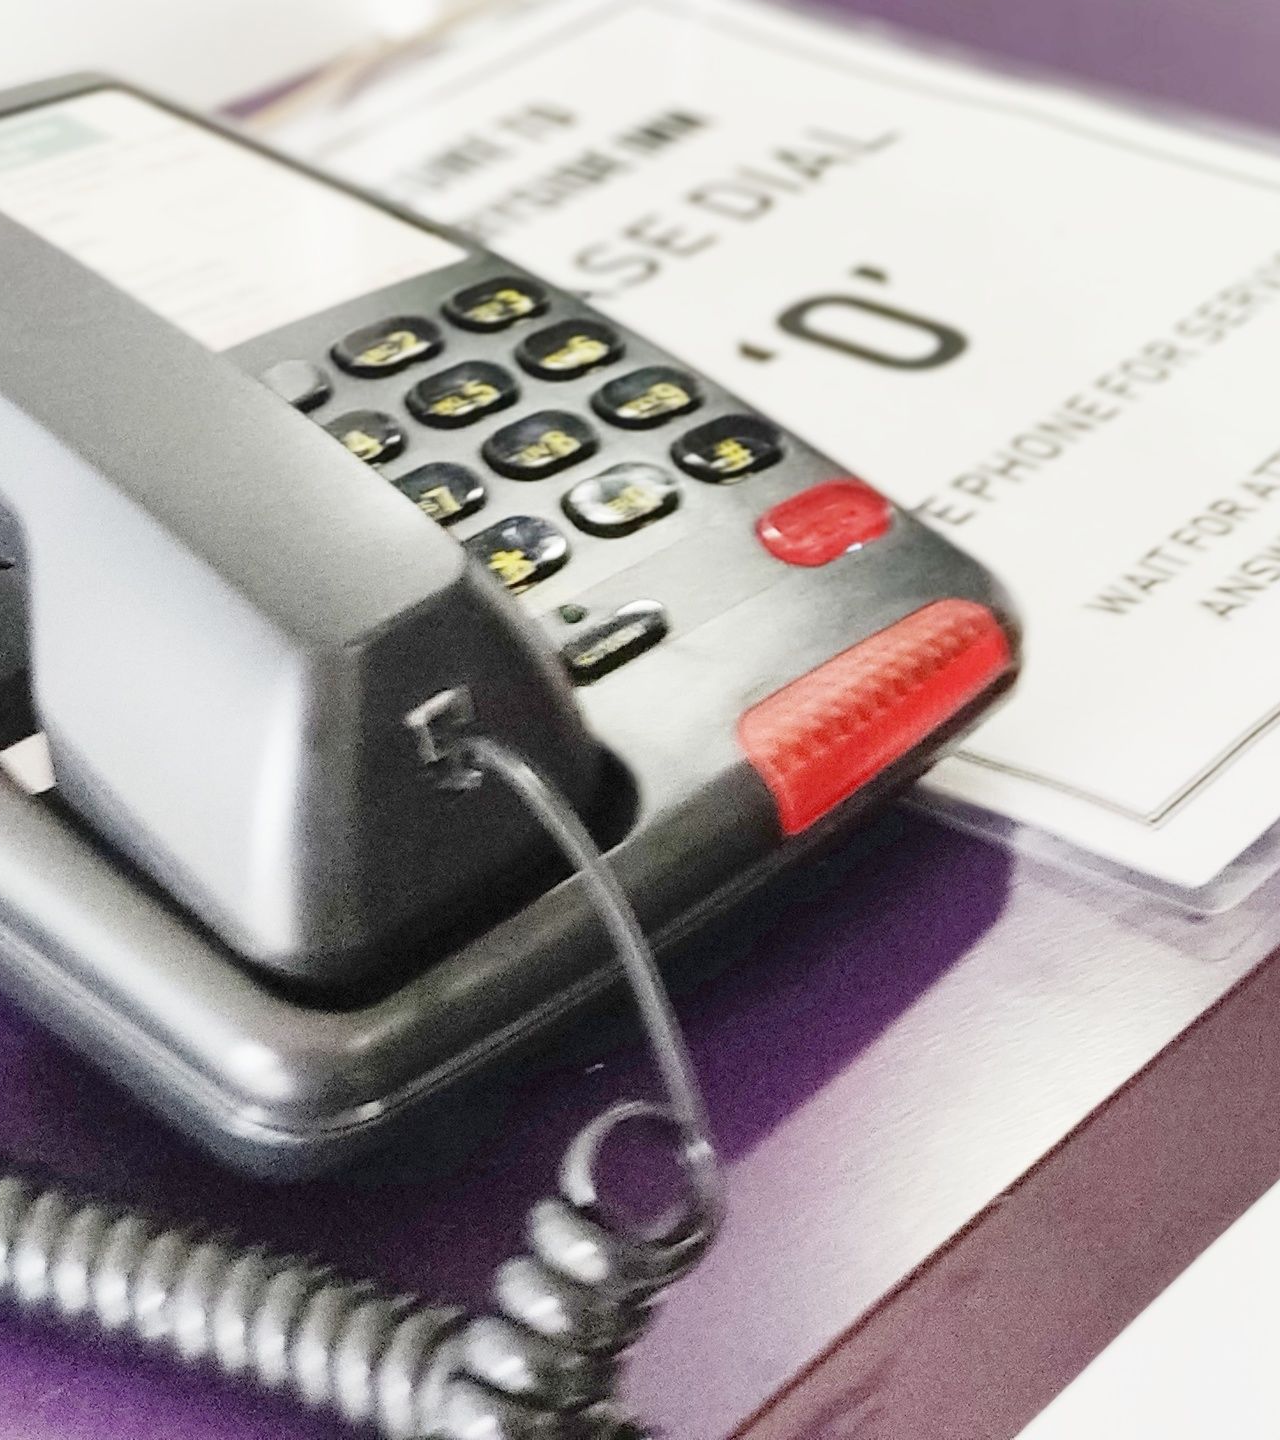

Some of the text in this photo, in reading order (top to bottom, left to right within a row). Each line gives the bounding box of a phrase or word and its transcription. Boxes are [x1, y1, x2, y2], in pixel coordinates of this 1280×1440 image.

[572, 126, 902, 301] SE DIAL
[908, 493, 981, 528] E
[950, 392, 1122, 503] PHONE
[1093, 337, 1201, 402] FOR
[1083, 545, 1192, 617] WAIT
[1169, 496, 1256, 553] FOR
